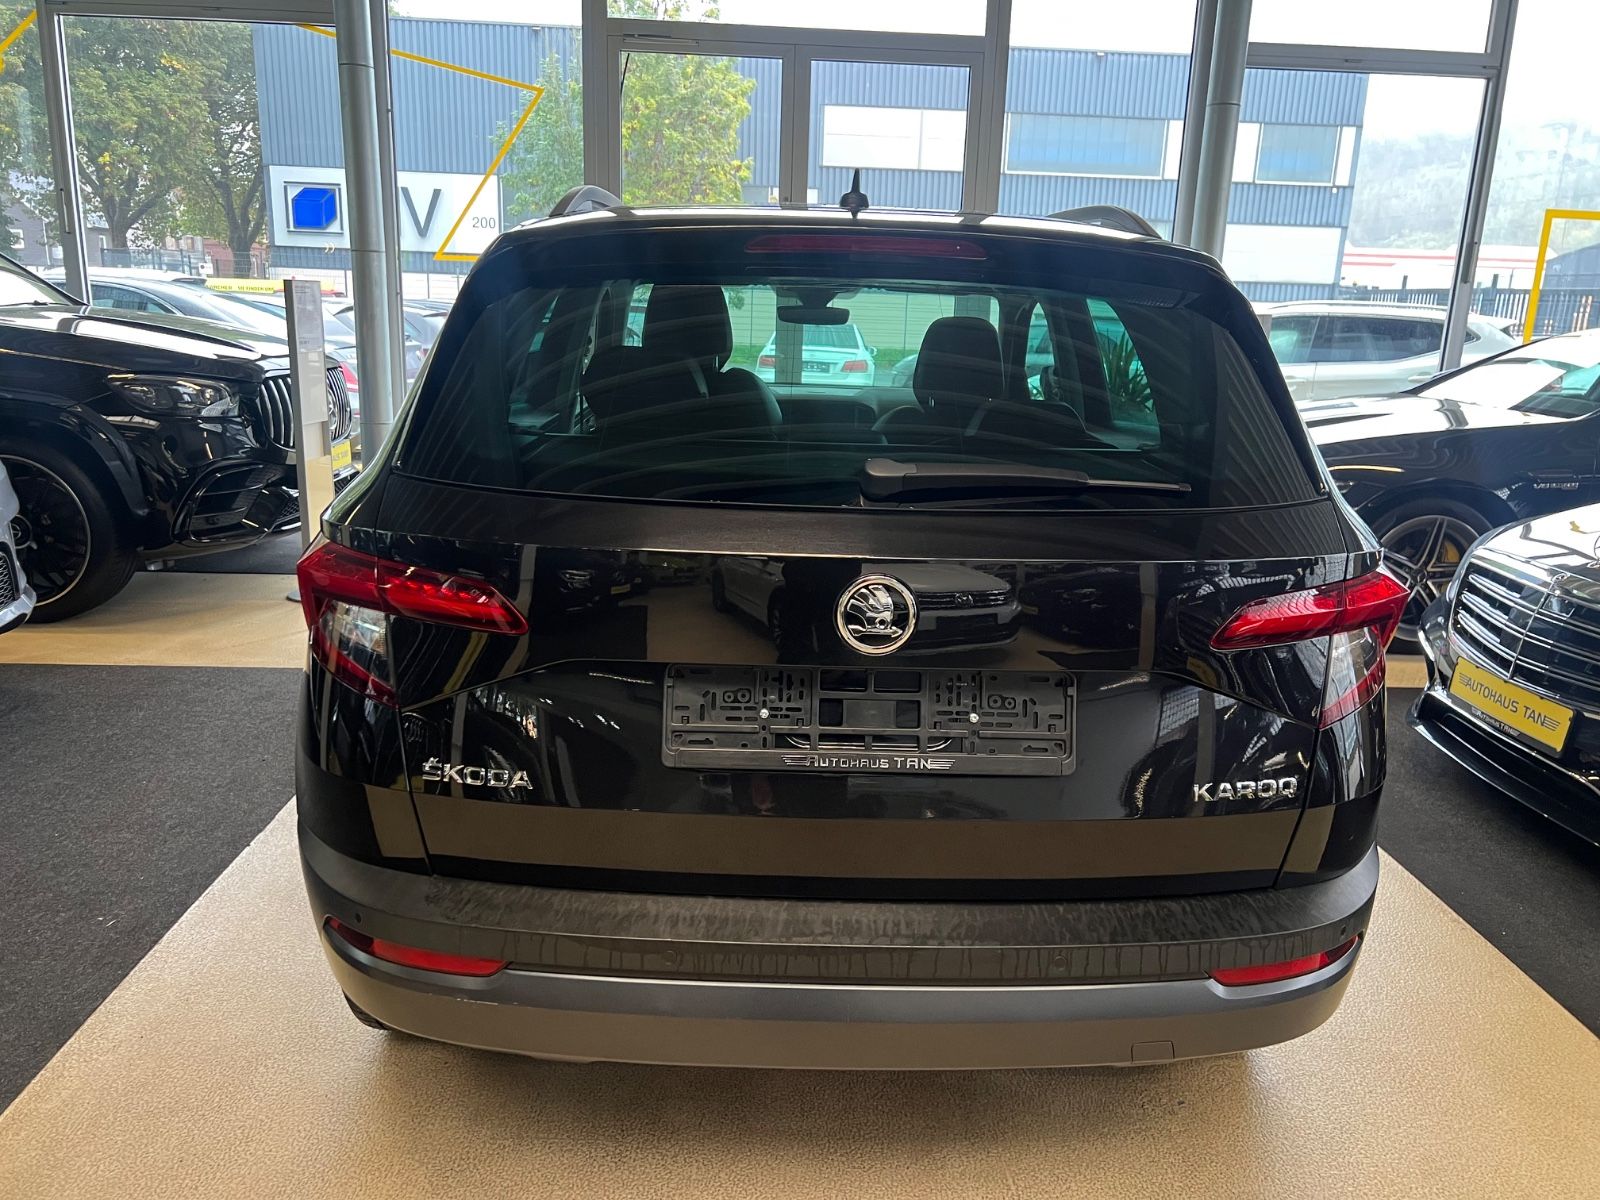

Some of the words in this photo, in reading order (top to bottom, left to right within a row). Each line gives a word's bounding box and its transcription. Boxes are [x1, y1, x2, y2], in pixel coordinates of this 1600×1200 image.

[472, 216, 496, 229] 200
[1465, 677, 1519, 714] AUTOHAUS
[1523, 705, 1547, 727] TAN
[806, 754, 889, 769] AUTOHAUS
[893, 757, 931, 770] TAN
[1193, 777, 1298, 802] KAROQ
